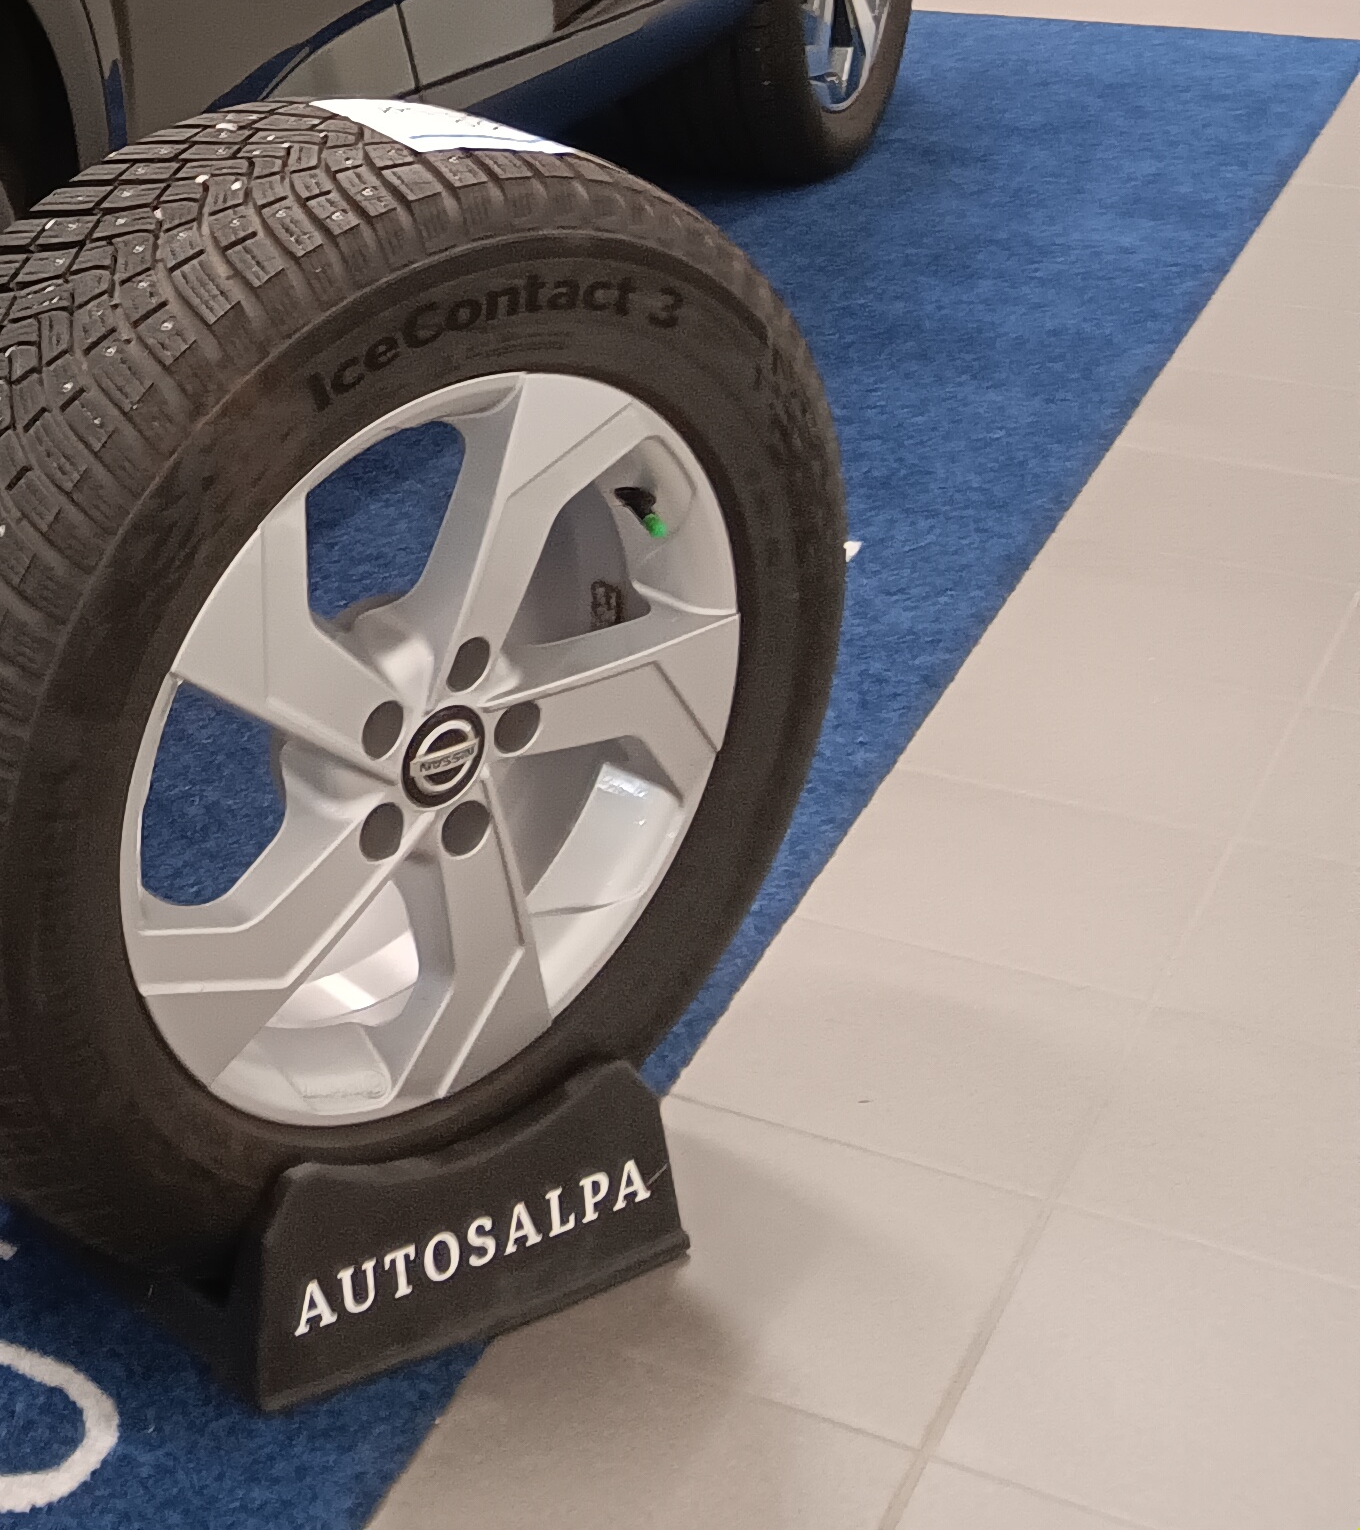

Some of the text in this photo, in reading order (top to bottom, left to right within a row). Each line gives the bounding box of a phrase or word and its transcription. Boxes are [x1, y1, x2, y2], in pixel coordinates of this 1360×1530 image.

[307, 273, 684, 413] IceContact 3
[293, 1159, 651, 1338] AUTOSALPA
